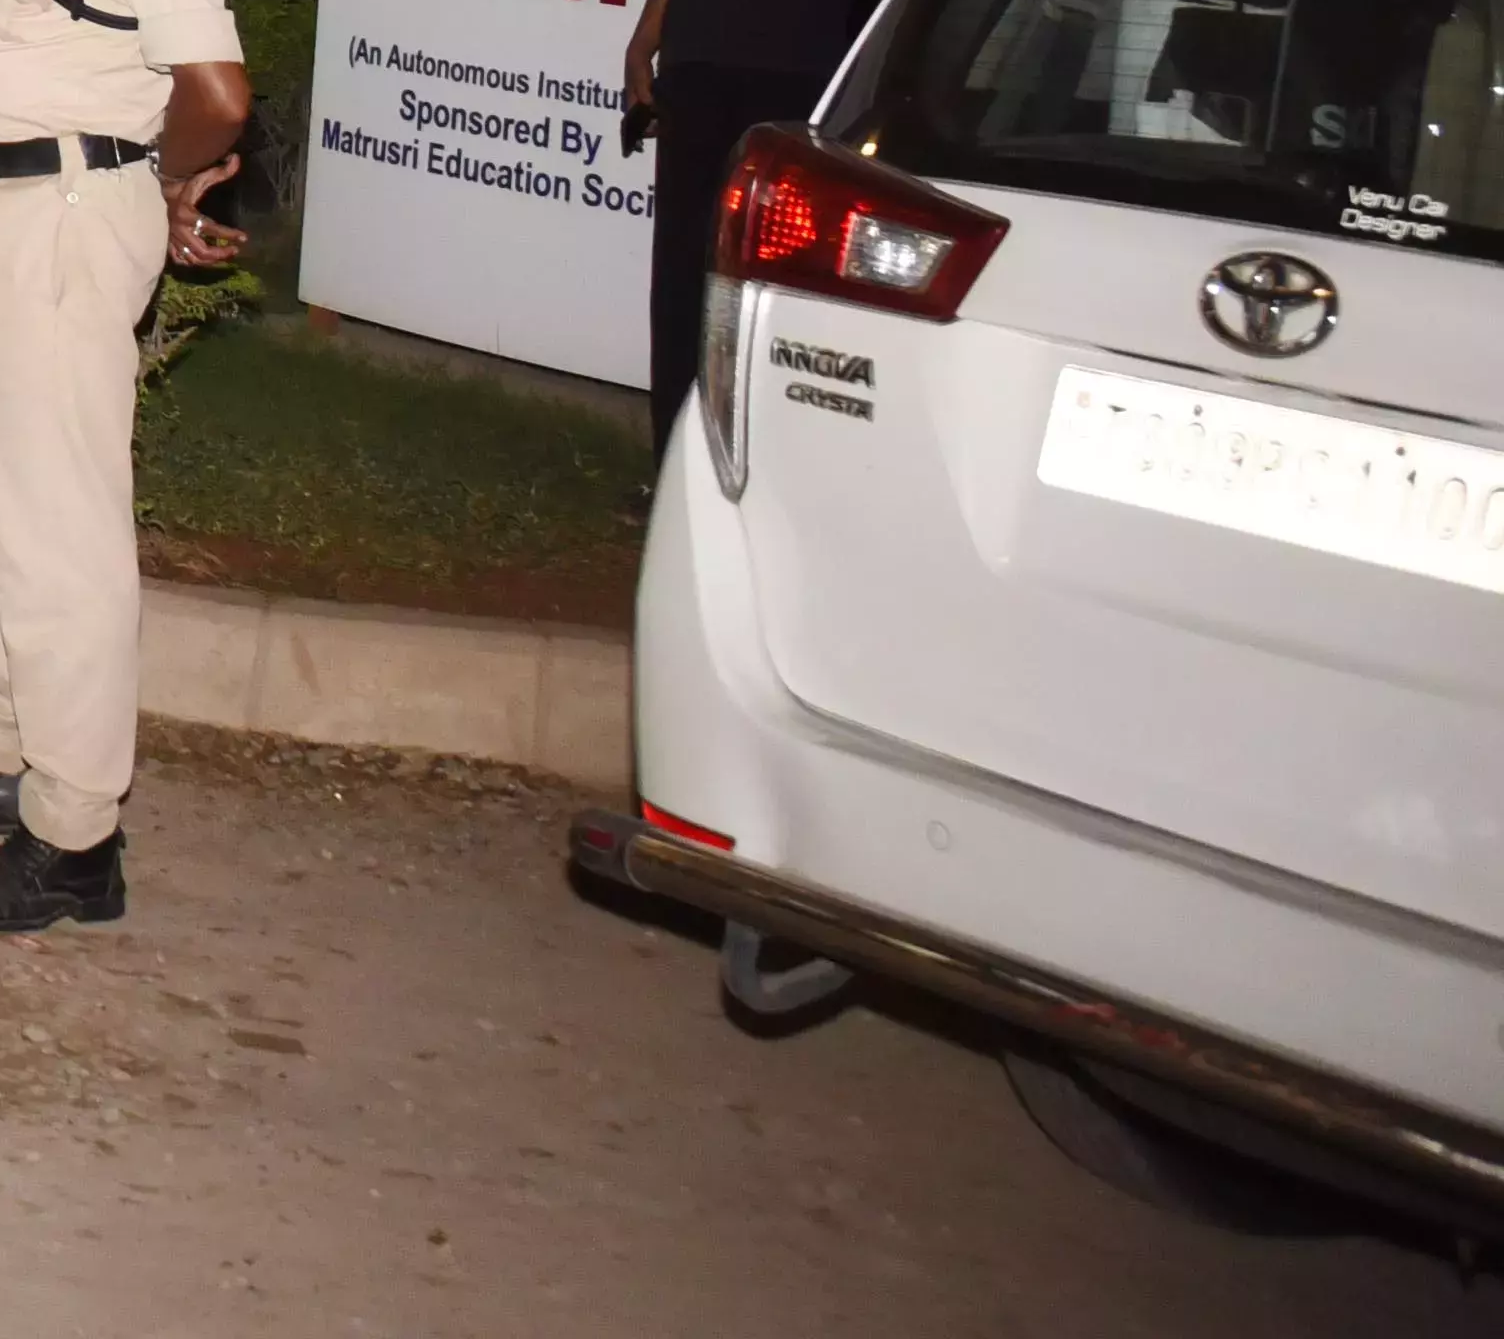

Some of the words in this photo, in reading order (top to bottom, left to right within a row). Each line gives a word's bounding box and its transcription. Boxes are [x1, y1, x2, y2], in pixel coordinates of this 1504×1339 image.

[349, 35, 382, 69] (An
[386, 43, 530, 95] Autonomous
[399, 88, 551, 150] Sponsored
[561, 120, 603, 166] By
[322, 117, 420, 170] Matrusri
[426, 142, 571, 203] Education
[1339, 206, 1448, 241] Designer
[1348, 184, 1405, 211] Venu
[769, 336, 876, 390] INNOVA
[785, 381, 874, 424] CRYSTA
